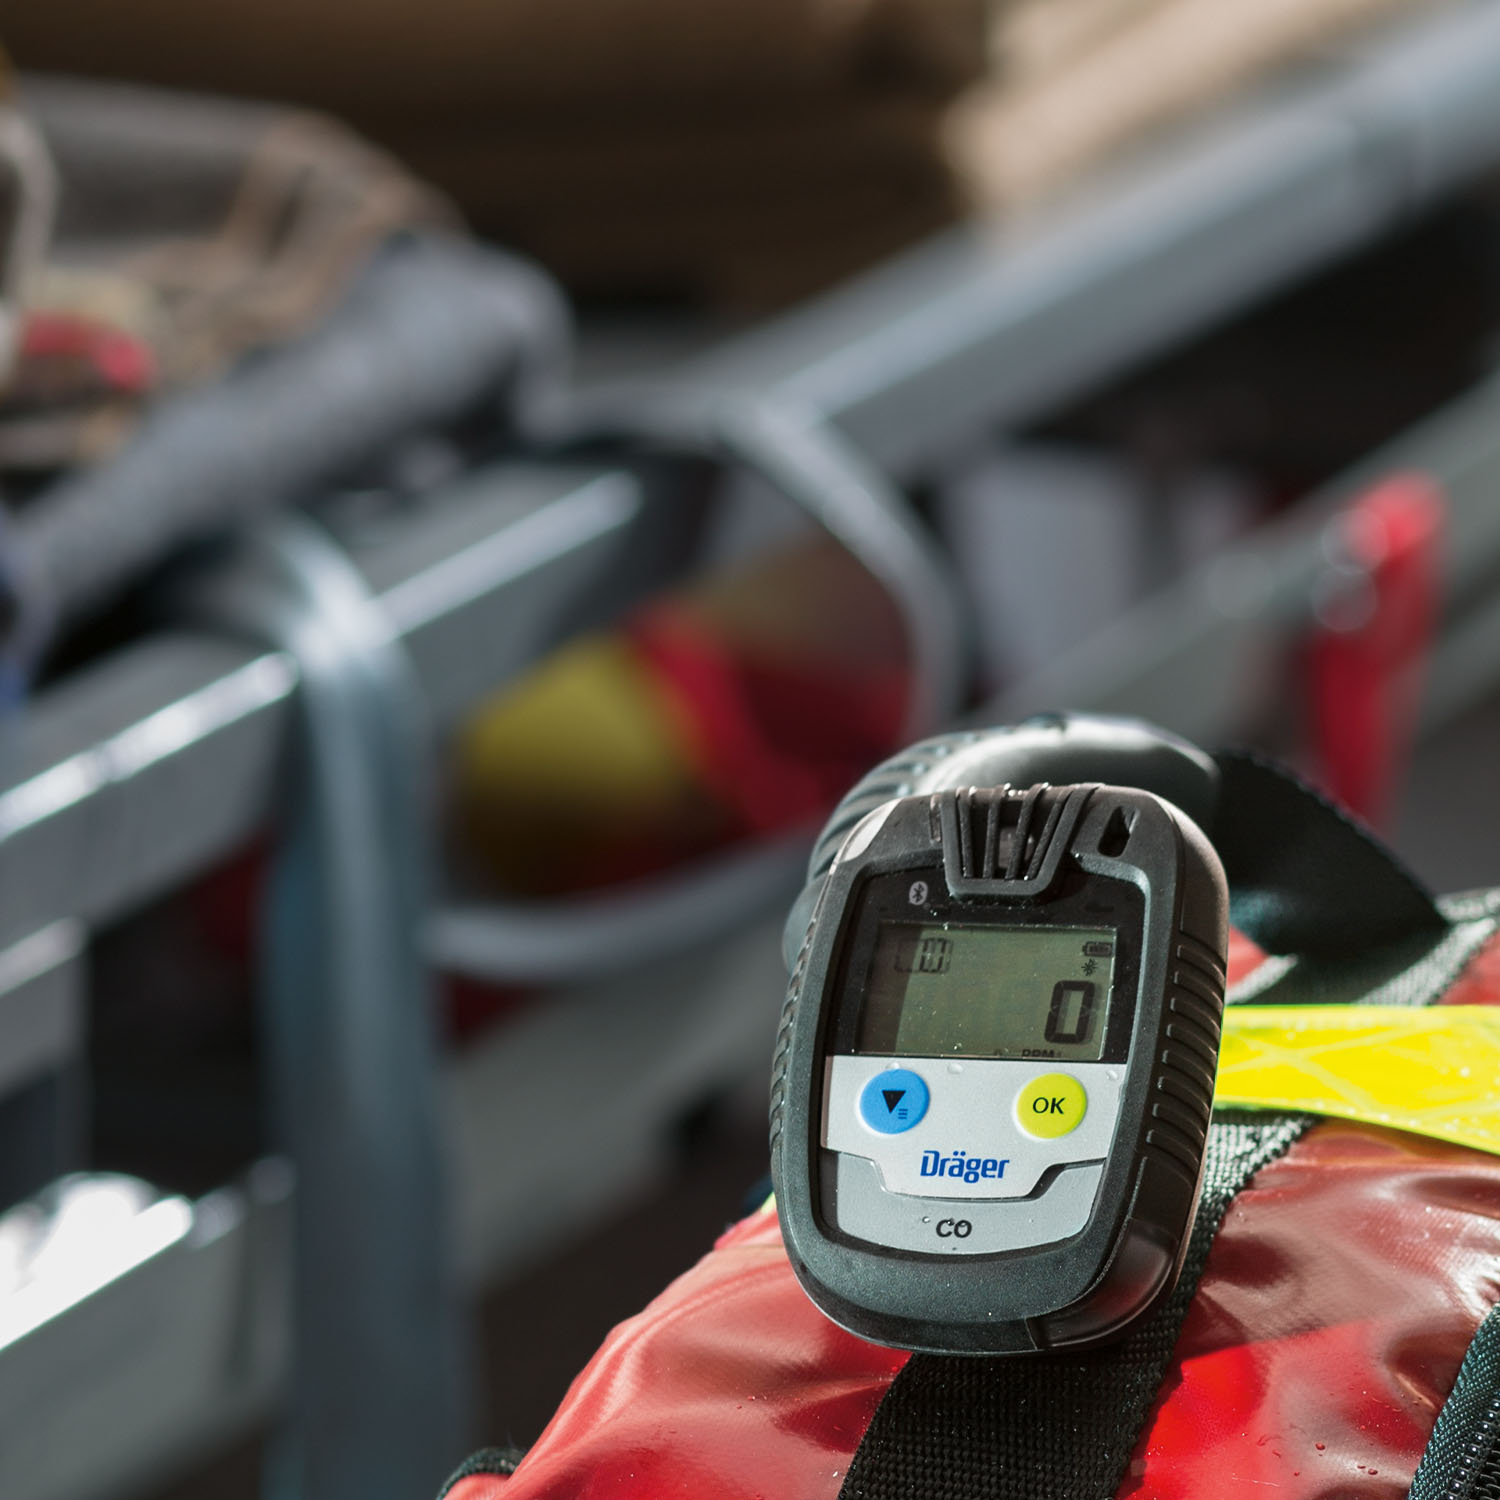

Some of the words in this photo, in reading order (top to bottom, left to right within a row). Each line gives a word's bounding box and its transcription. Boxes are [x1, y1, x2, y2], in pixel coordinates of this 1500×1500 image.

[1044, 980, 1096, 1044] 0
[1032, 1096, 1066, 1115] OK
[920, 1150, 1010, 1184] Dräger
[936, 1218, 973, 1239] CO
